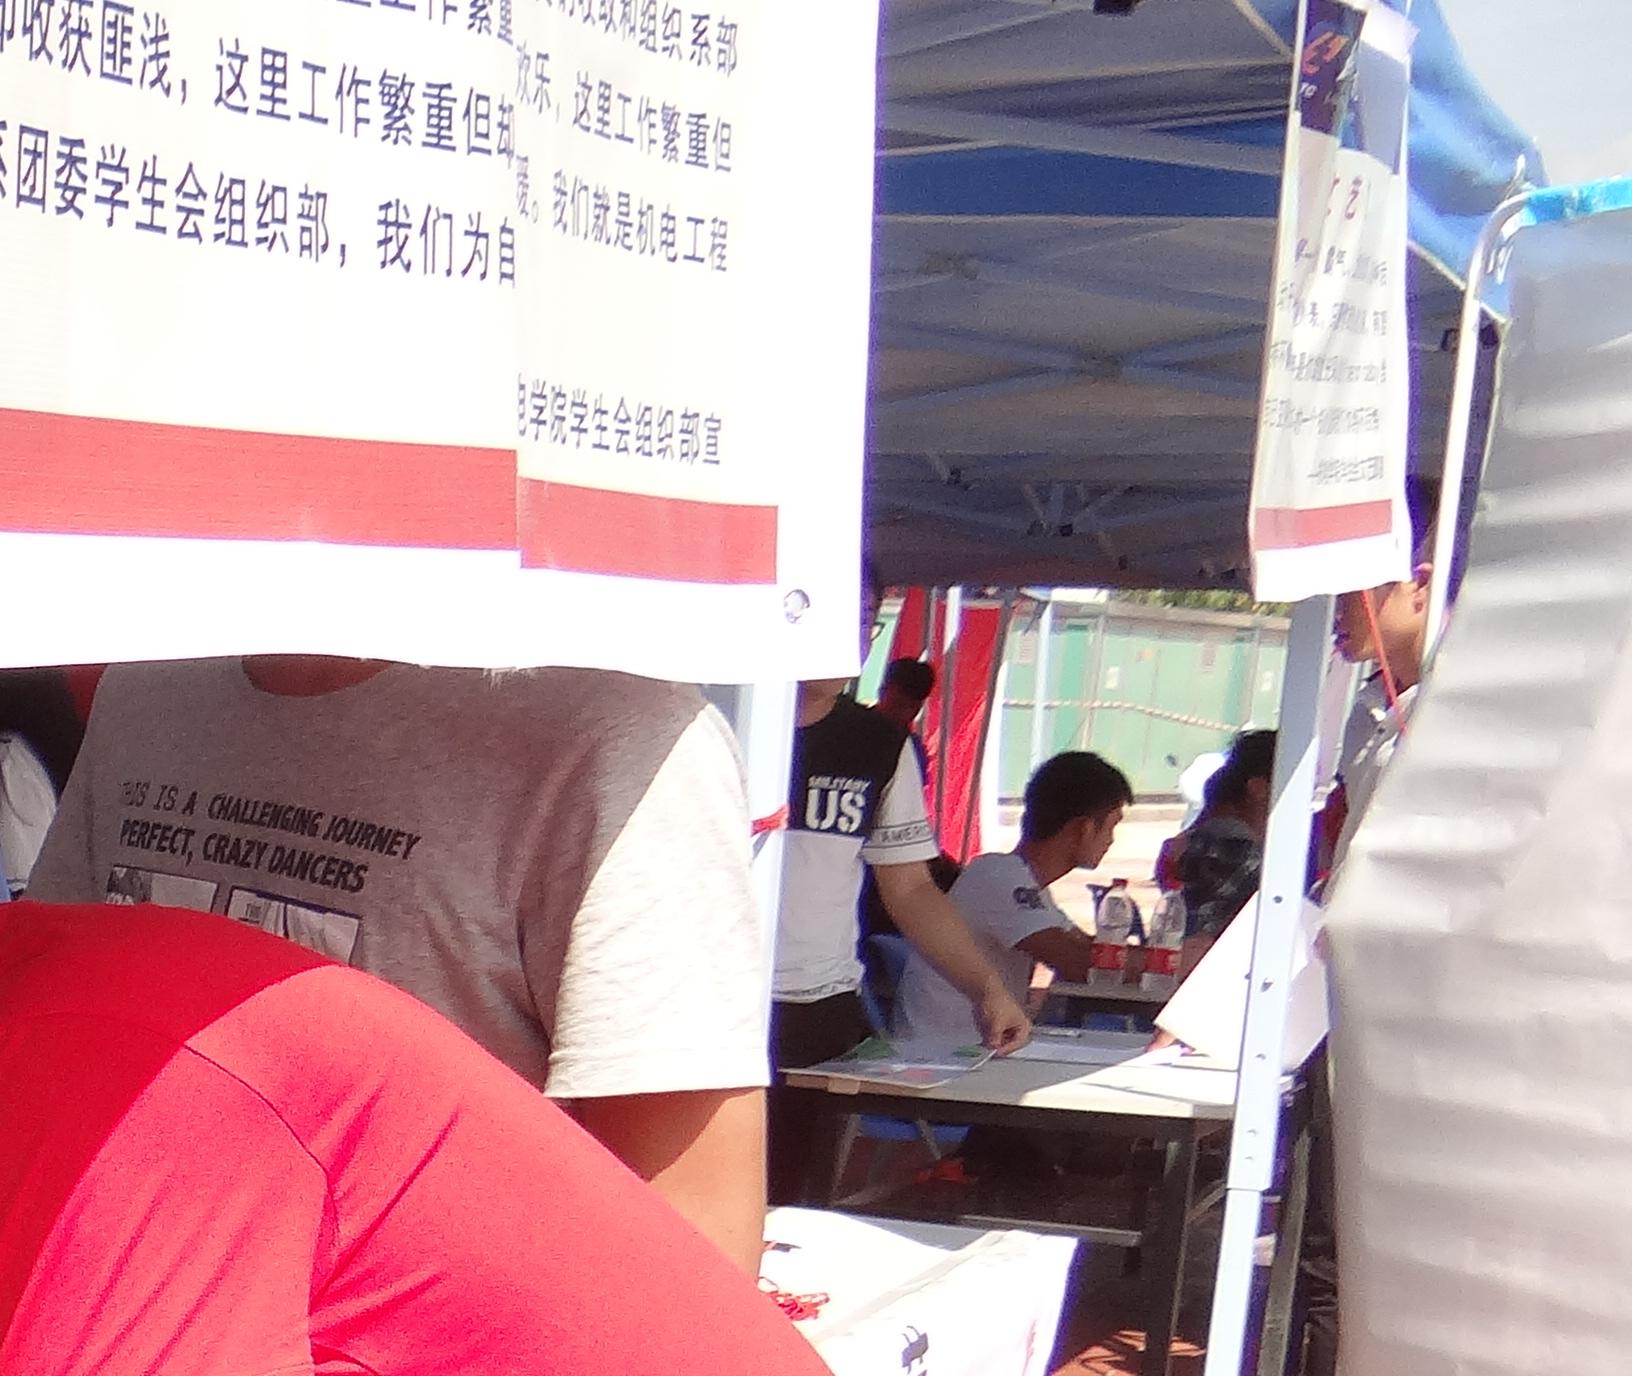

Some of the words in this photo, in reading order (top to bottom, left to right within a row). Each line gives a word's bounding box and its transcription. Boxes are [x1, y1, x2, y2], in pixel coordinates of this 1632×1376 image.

[153, 784, 179, 812] IS
[182, 790, 198, 816] A
[207, 792, 325, 838] CHALLENGING
[321, 813, 423, 861] JOURNEY
[805, 788, 867, 834] US
[119, 818, 196, 868] PERFECT,
[202, 831, 271, 871] CRAZY
[268, 845, 370, 894] DANCERS
